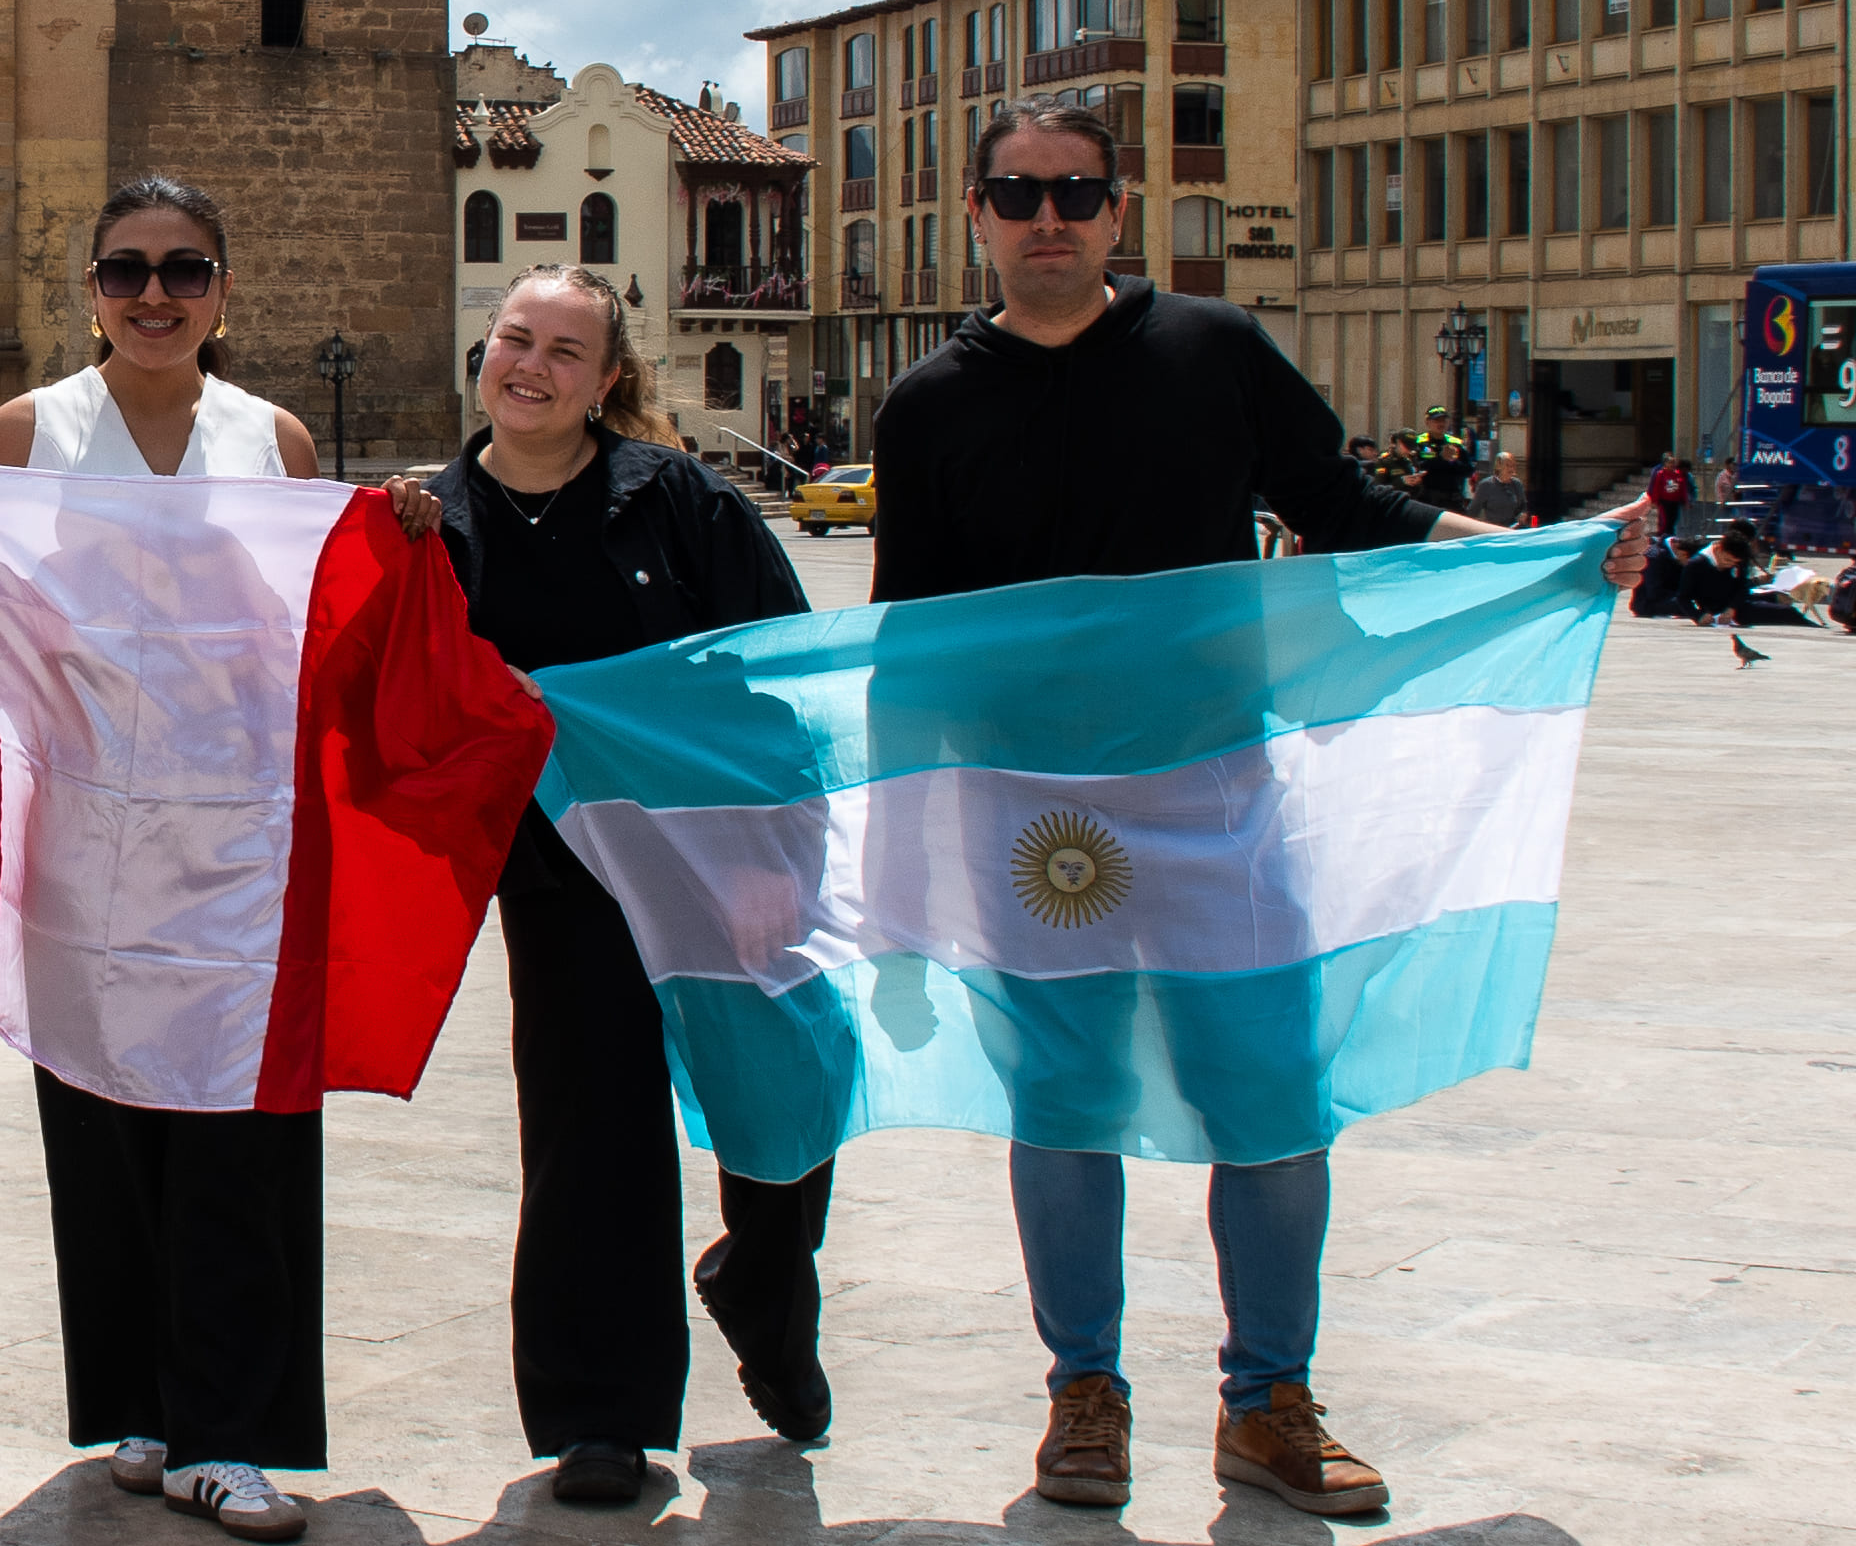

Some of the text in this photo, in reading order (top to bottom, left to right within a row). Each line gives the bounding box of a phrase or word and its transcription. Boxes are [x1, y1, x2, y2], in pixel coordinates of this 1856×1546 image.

[1226, 205, 1296, 219] HOTEL
[1248, 226, 1273, 241] SAN
[1226, 244, 1294, 259] FRANCISCO
[1589, 317, 1641, 338] movistar
[1754, 366, 1798, 383] Banco de
[1757, 387, 1793, 408] Bogotá
[1752, 451, 1794, 466] AVAL
